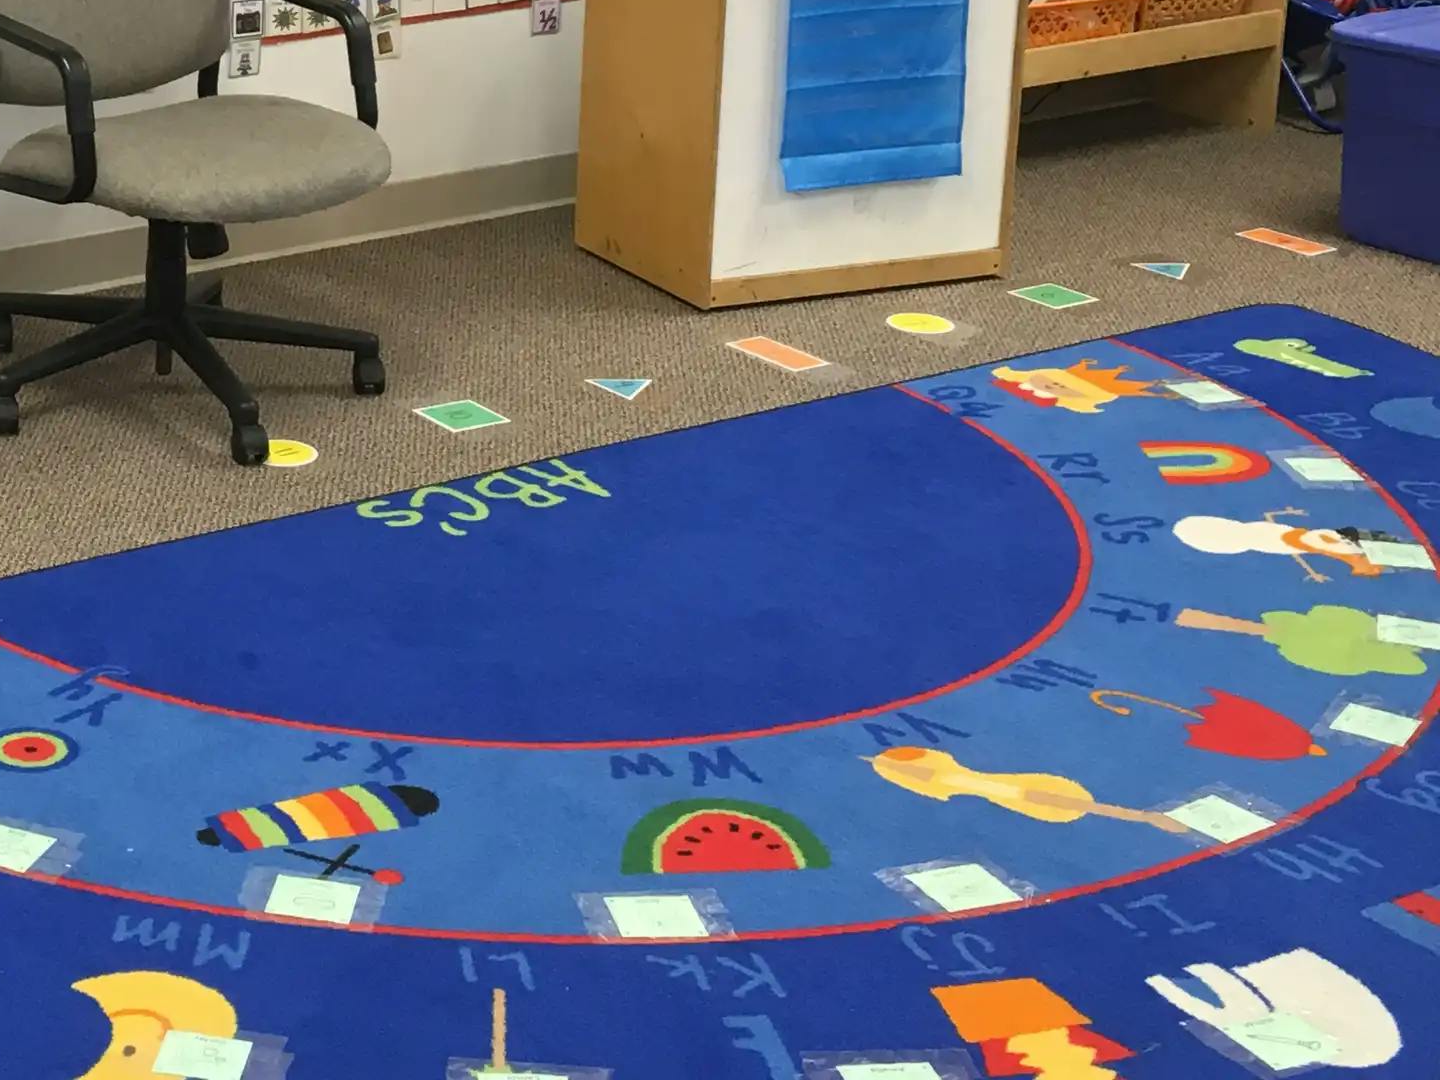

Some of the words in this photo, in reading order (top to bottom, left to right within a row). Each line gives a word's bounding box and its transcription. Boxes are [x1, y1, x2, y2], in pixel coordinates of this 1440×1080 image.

[356, 459, 612, 536] ABC's
[303, 740, 414, 782] Xx
[610, 746, 762, 786] Ww
[111, 914, 253, 971] Mm
[646, 951, 787, 999] Kk
